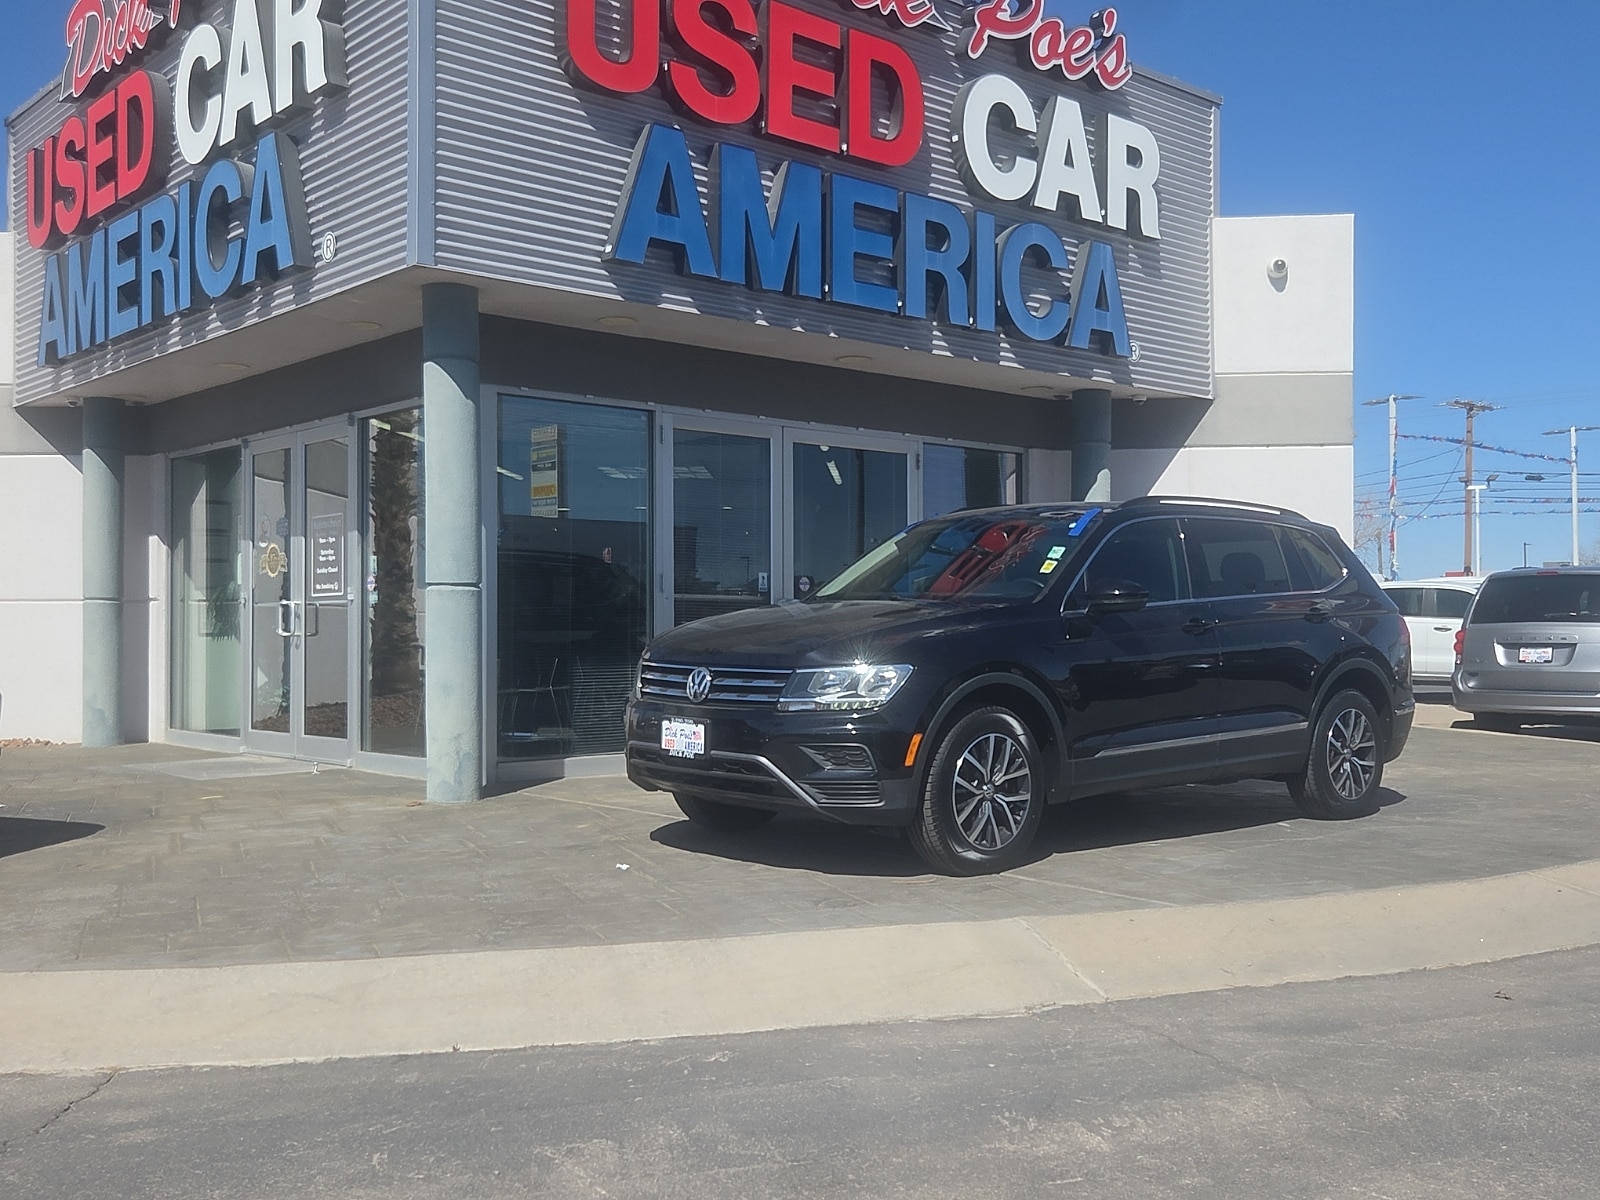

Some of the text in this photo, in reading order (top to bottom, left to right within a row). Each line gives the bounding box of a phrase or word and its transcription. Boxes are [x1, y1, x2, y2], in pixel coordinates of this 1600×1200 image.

[27, 0, 328, 250] USED CAR
[567, 0, 1162, 240] USED CAR
[37, 132, 294, 367] AMERICA
[612, 123, 1132, 357] AMERICA
[664, 727, 678, 738] Dick
[684, 741, 703, 752] AMERICA
